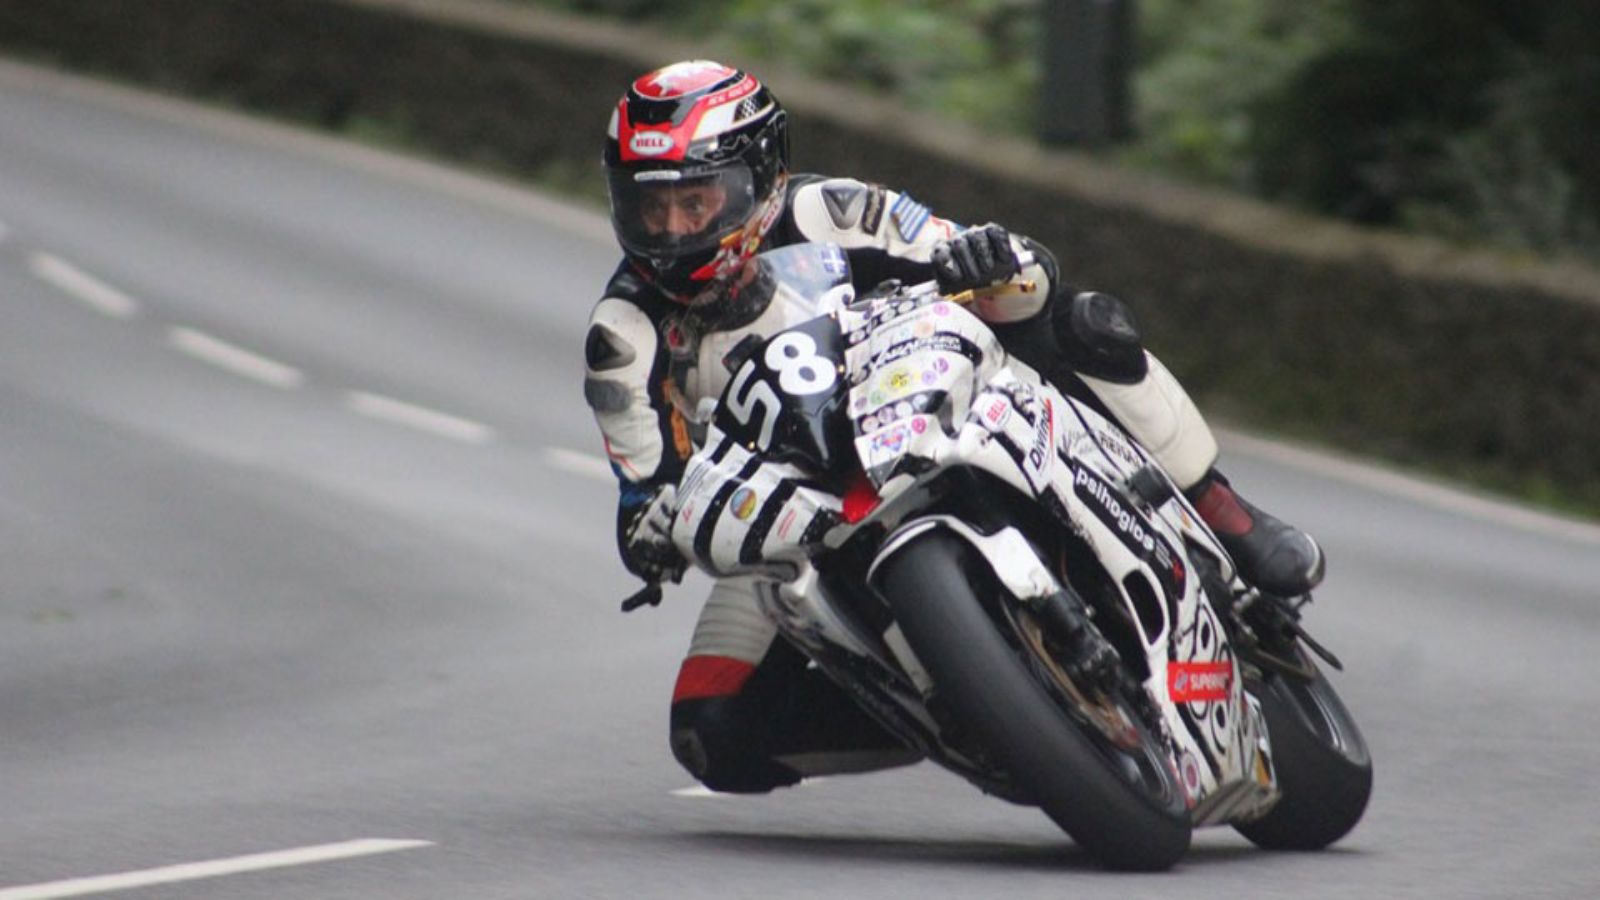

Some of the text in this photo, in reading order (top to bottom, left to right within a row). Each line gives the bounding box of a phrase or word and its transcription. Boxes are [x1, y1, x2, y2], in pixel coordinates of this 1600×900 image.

[636, 138, 664, 148] BELL
[726, 331, 837, 452] 58
[986, 399, 1008, 423] BELL
